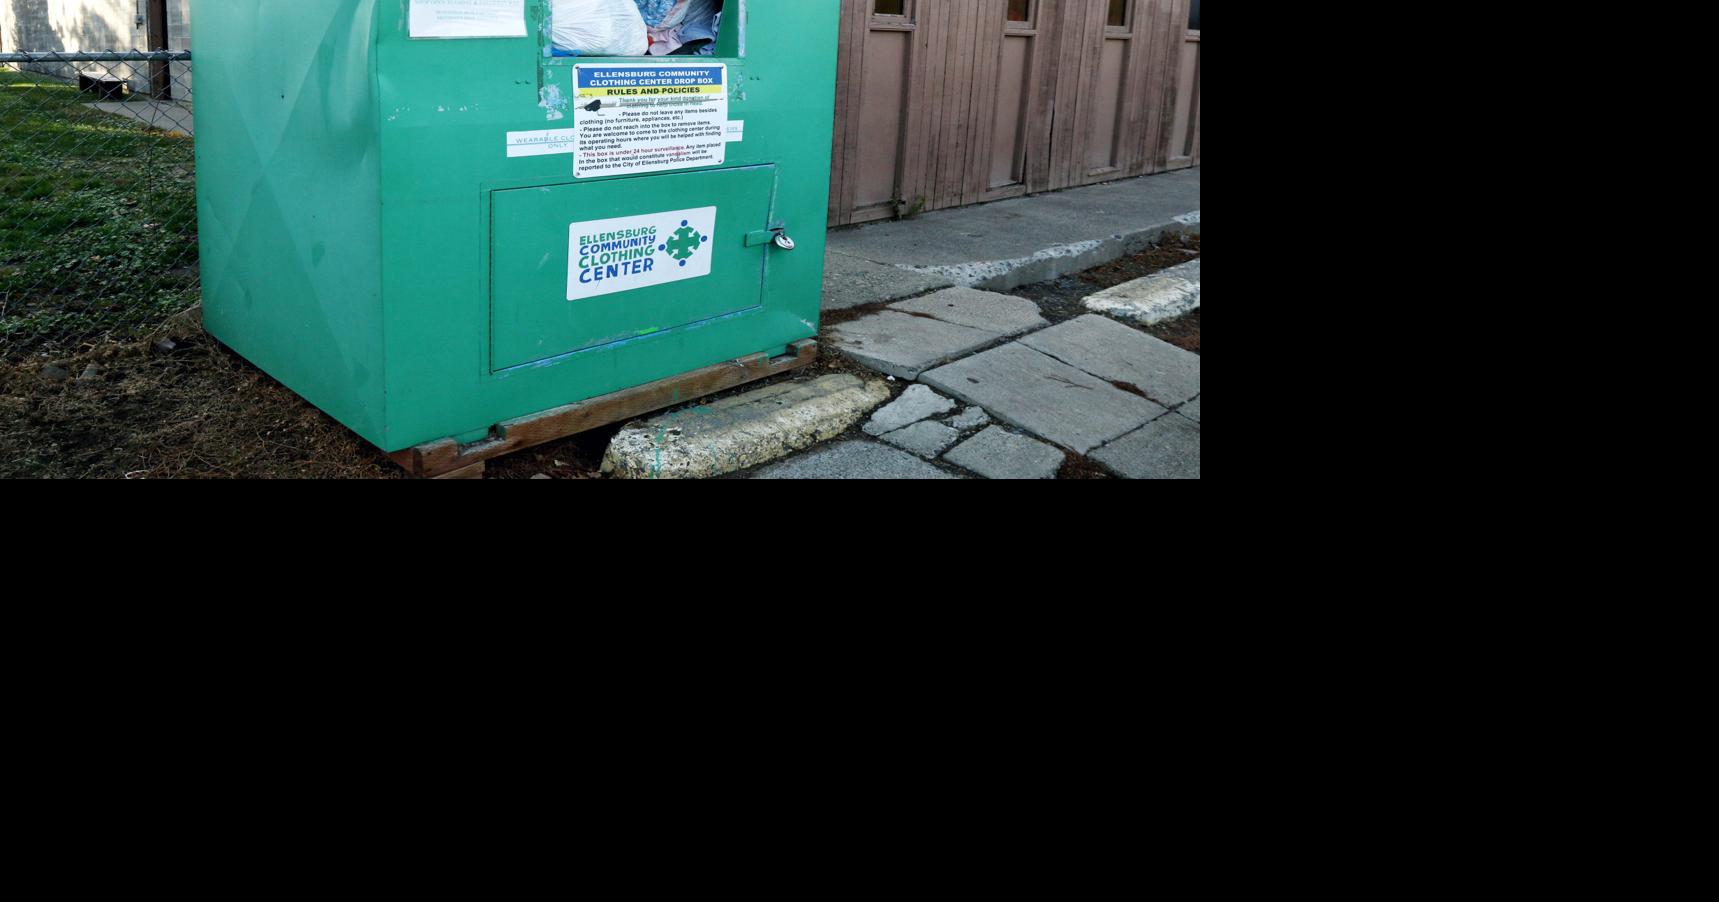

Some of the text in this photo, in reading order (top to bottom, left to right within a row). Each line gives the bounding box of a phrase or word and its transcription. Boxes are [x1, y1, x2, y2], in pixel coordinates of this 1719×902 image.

[579, 225, 657, 246] ELLENSBURG
[579, 235, 656, 256] COMMUNITY
[578, 245, 655, 269] CLOTHING
[579, 258, 654, 284] CENTER
